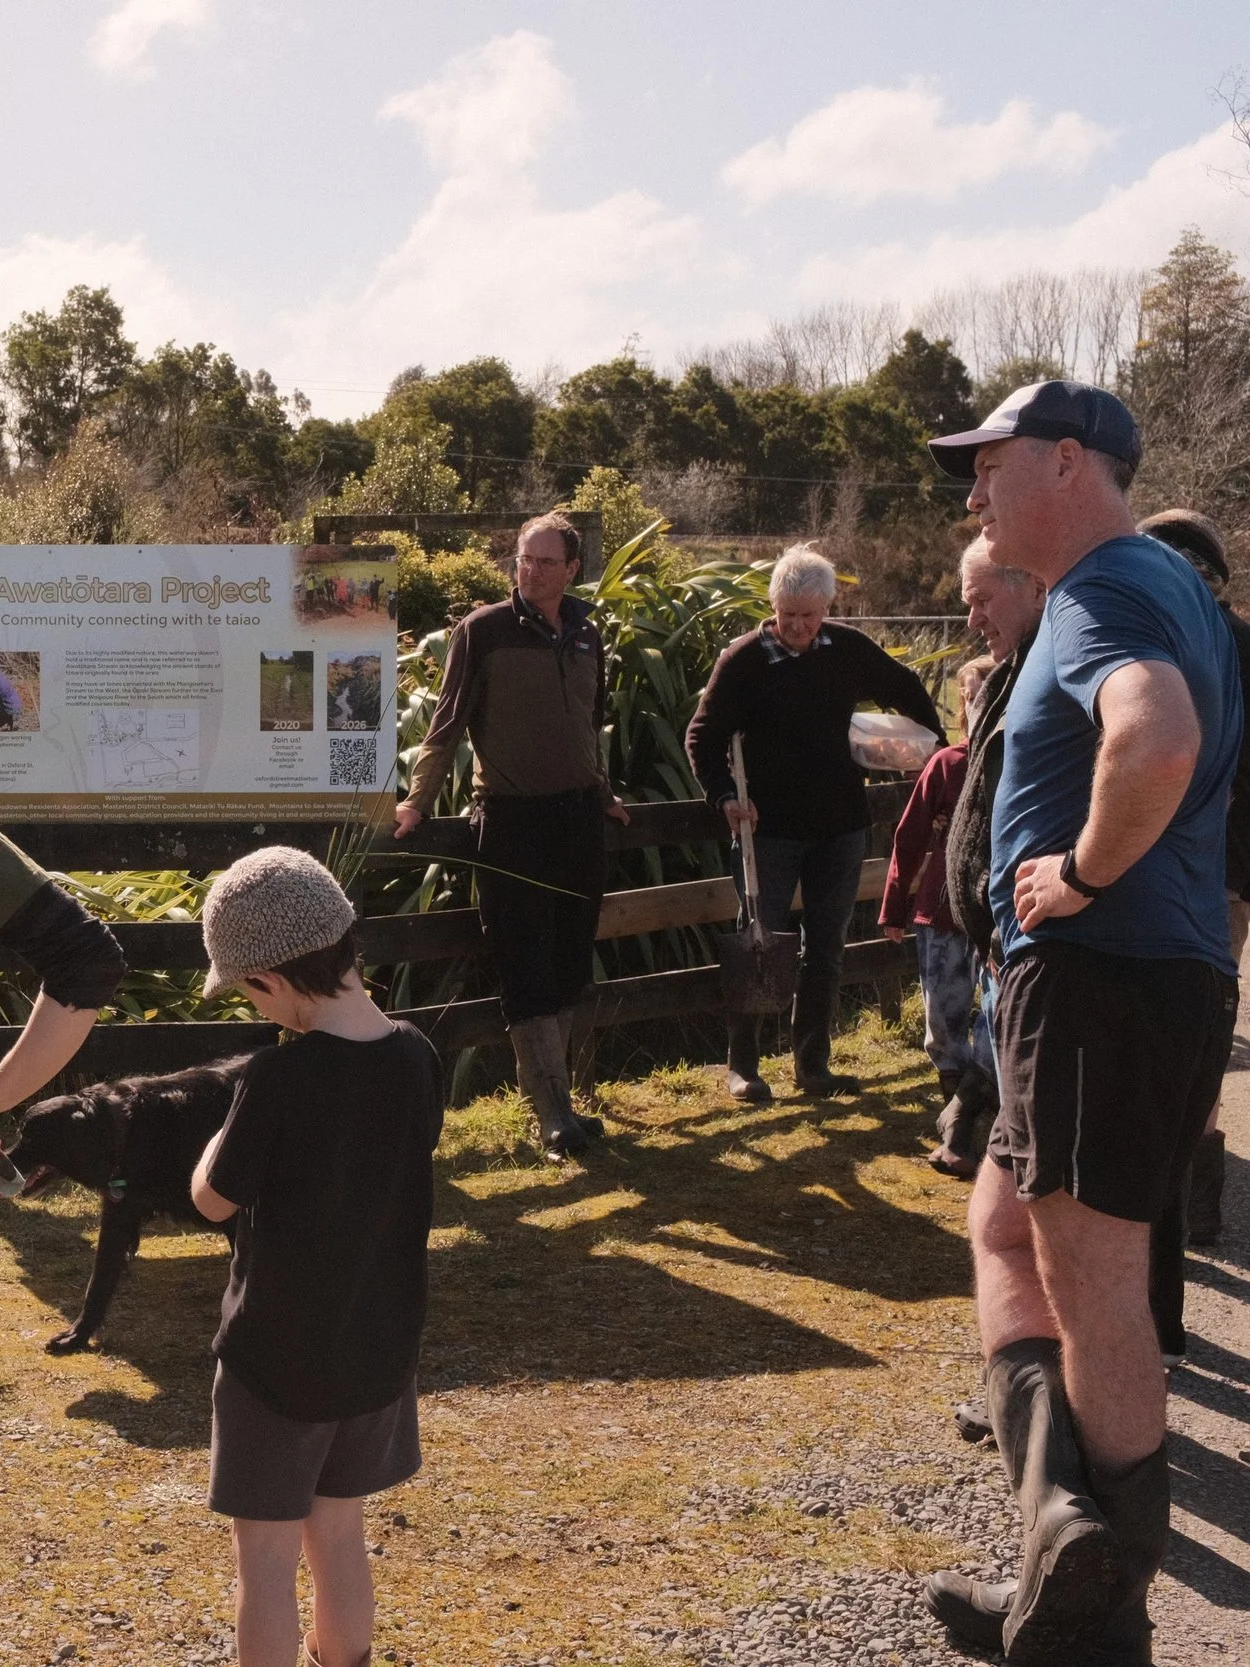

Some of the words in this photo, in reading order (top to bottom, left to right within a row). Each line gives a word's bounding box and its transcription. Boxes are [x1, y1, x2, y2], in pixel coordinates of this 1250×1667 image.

[161, 575, 271, 610] Project
[1, 615, 83, 628] Community
[88, 614, 167, 628] connecting
[172, 614, 202, 625] with
[208, 615, 221, 625] te
[226, 614, 260, 625] taiao
[273, 721, 300, 729] 2020
[341, 721, 367, 729] 2026
